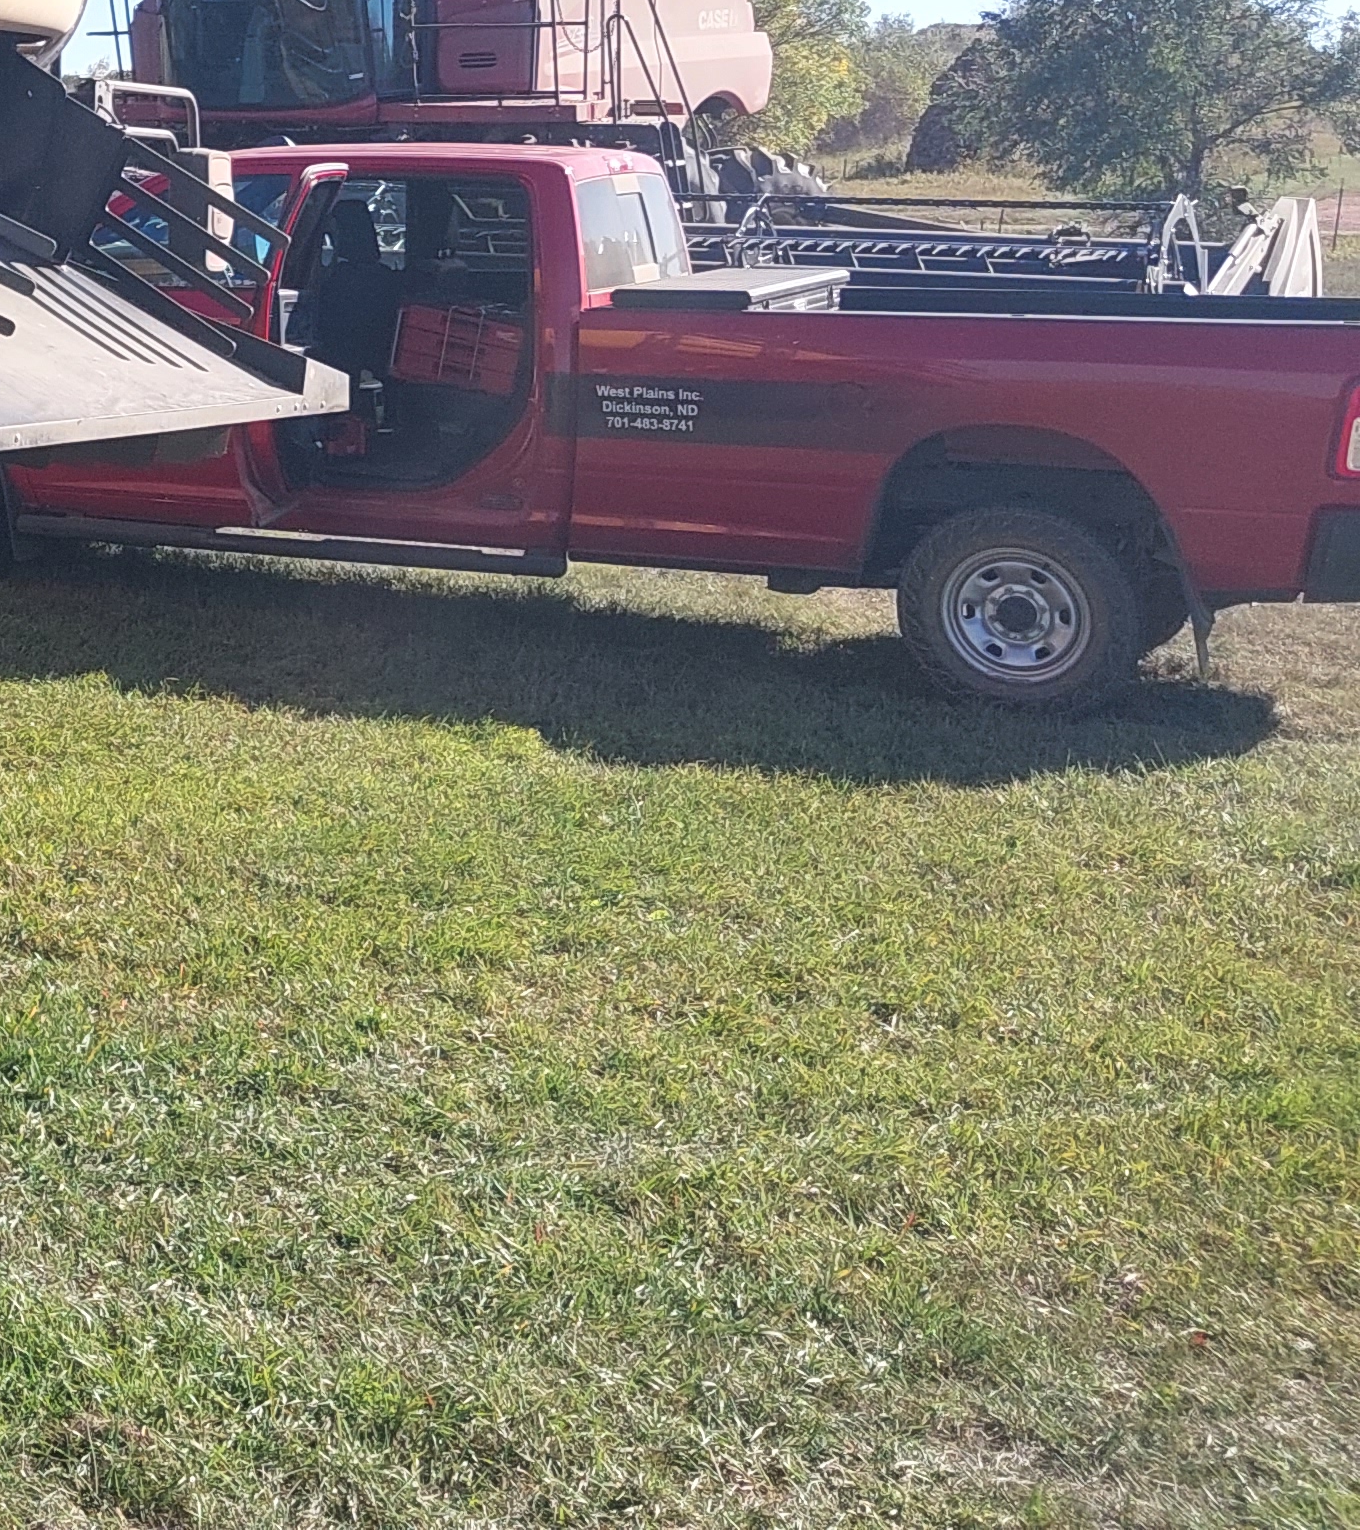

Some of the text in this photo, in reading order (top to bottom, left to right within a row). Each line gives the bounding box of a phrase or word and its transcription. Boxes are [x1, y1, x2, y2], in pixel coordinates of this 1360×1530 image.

[698, 8, 729, 30] CASE
[595, 384, 704, 401] West Plains Inc.
[602, 401, 698, 417] Dickinson, ND
